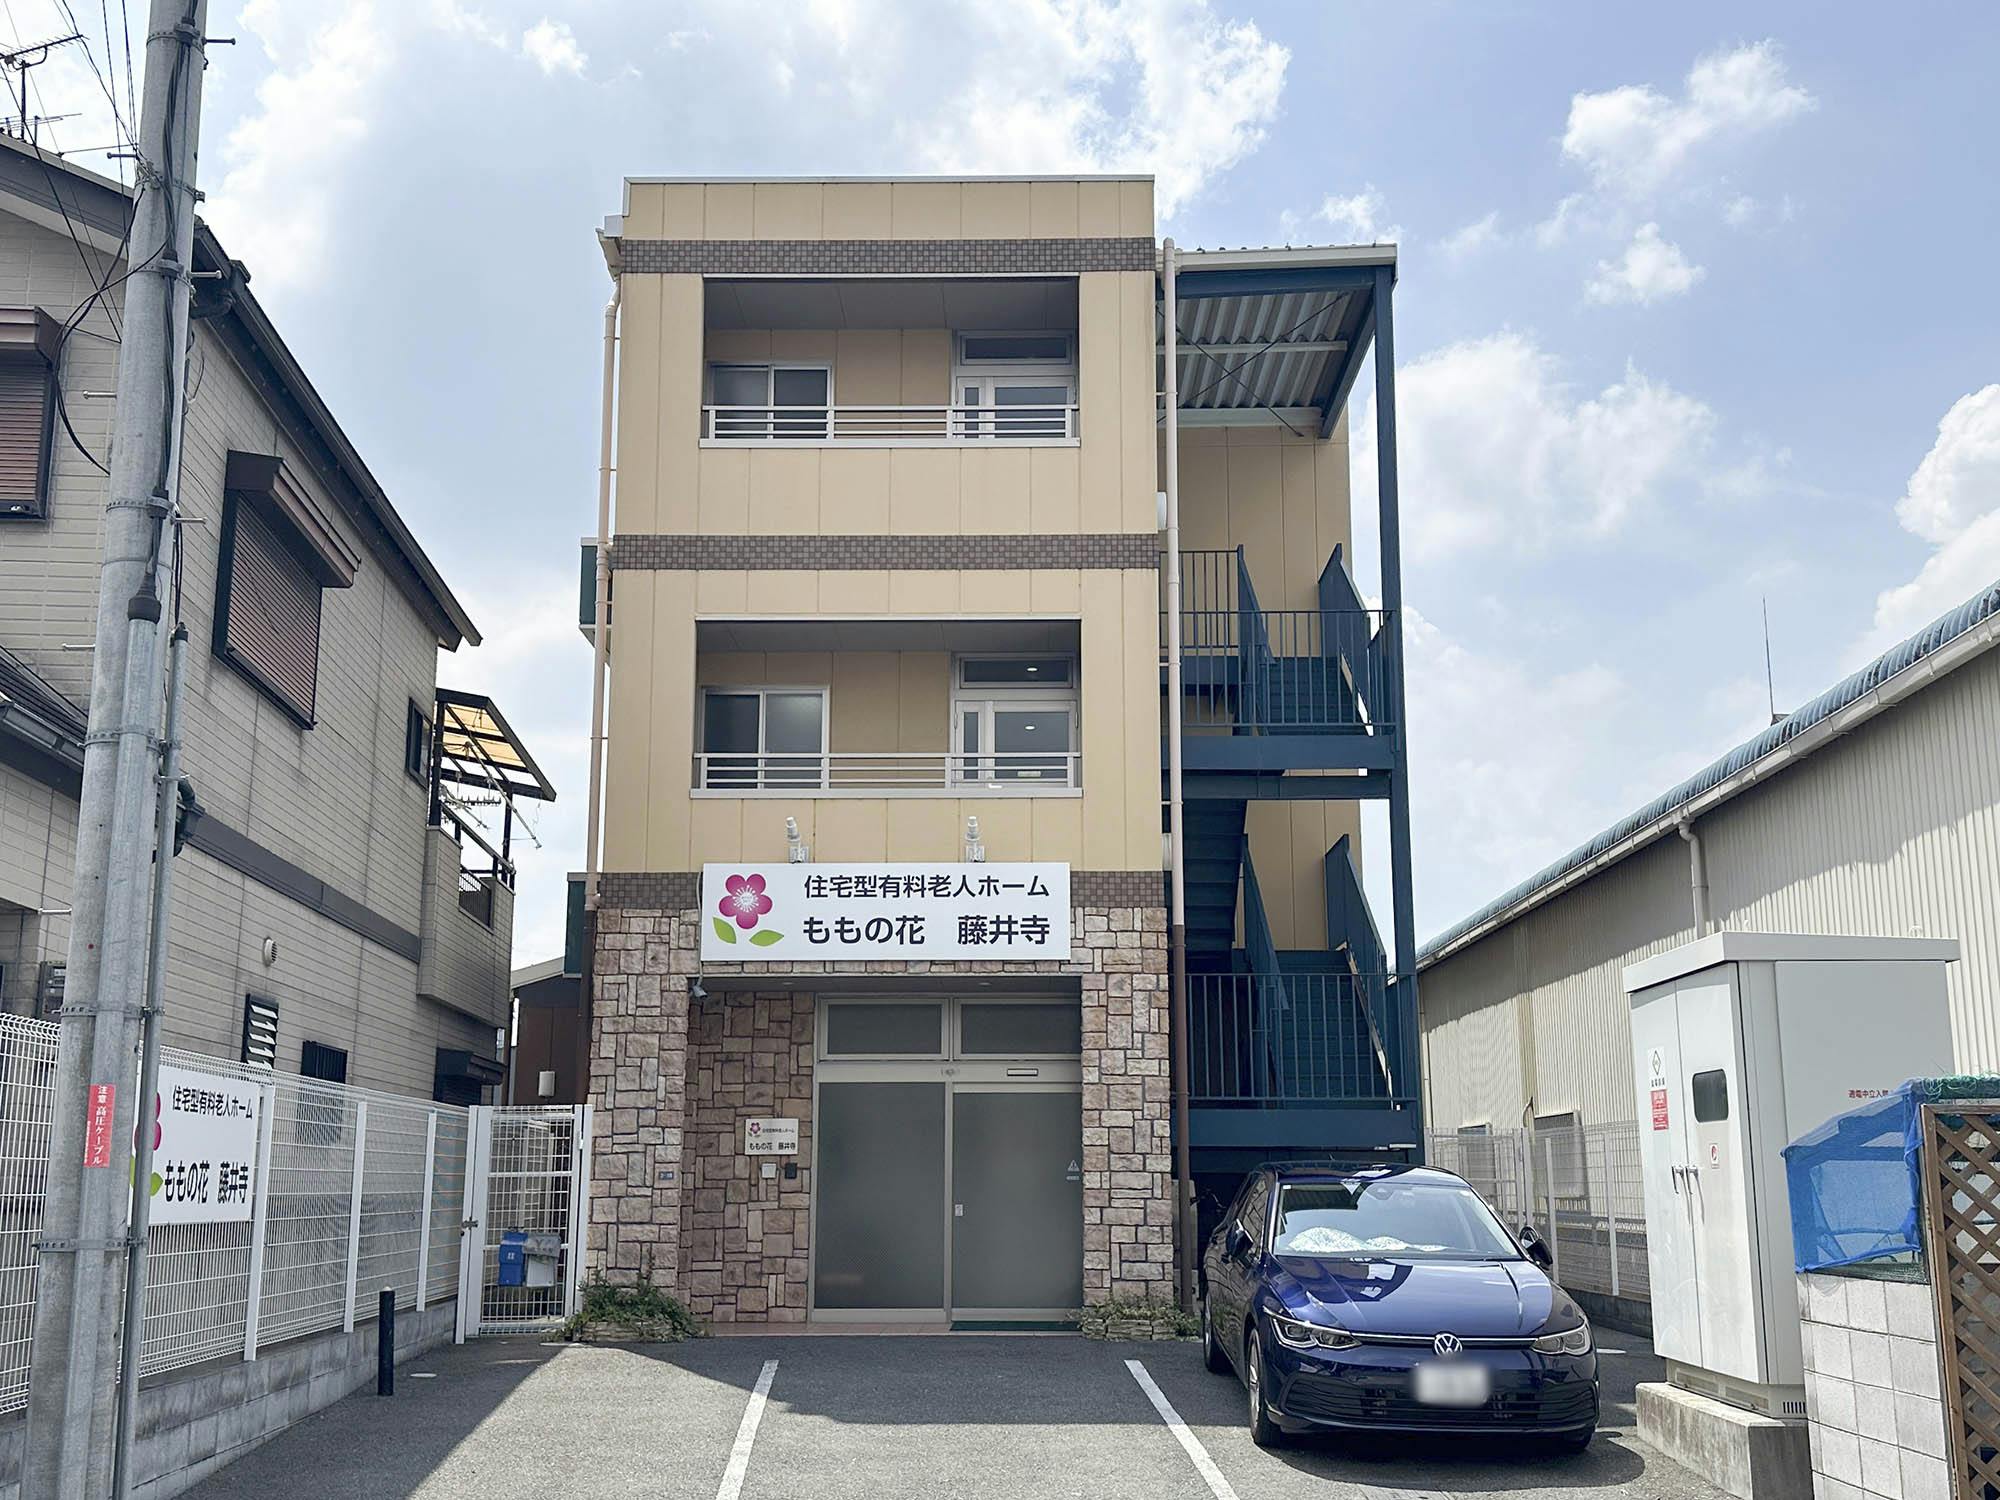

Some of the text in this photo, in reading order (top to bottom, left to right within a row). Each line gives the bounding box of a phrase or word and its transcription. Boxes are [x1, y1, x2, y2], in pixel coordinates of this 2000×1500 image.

[803, 874, 1050, 899] 住宅型有料老人ホーム
[803, 914, 1050, 945] ももの花 藤井寺
[172, 1084, 253, 1120] 住宅型有料老人ホーム
[92, 1105, 107, 1165] 高圧ケーブル
[164, 1160, 249, 1204] ももの花 藤井寺
